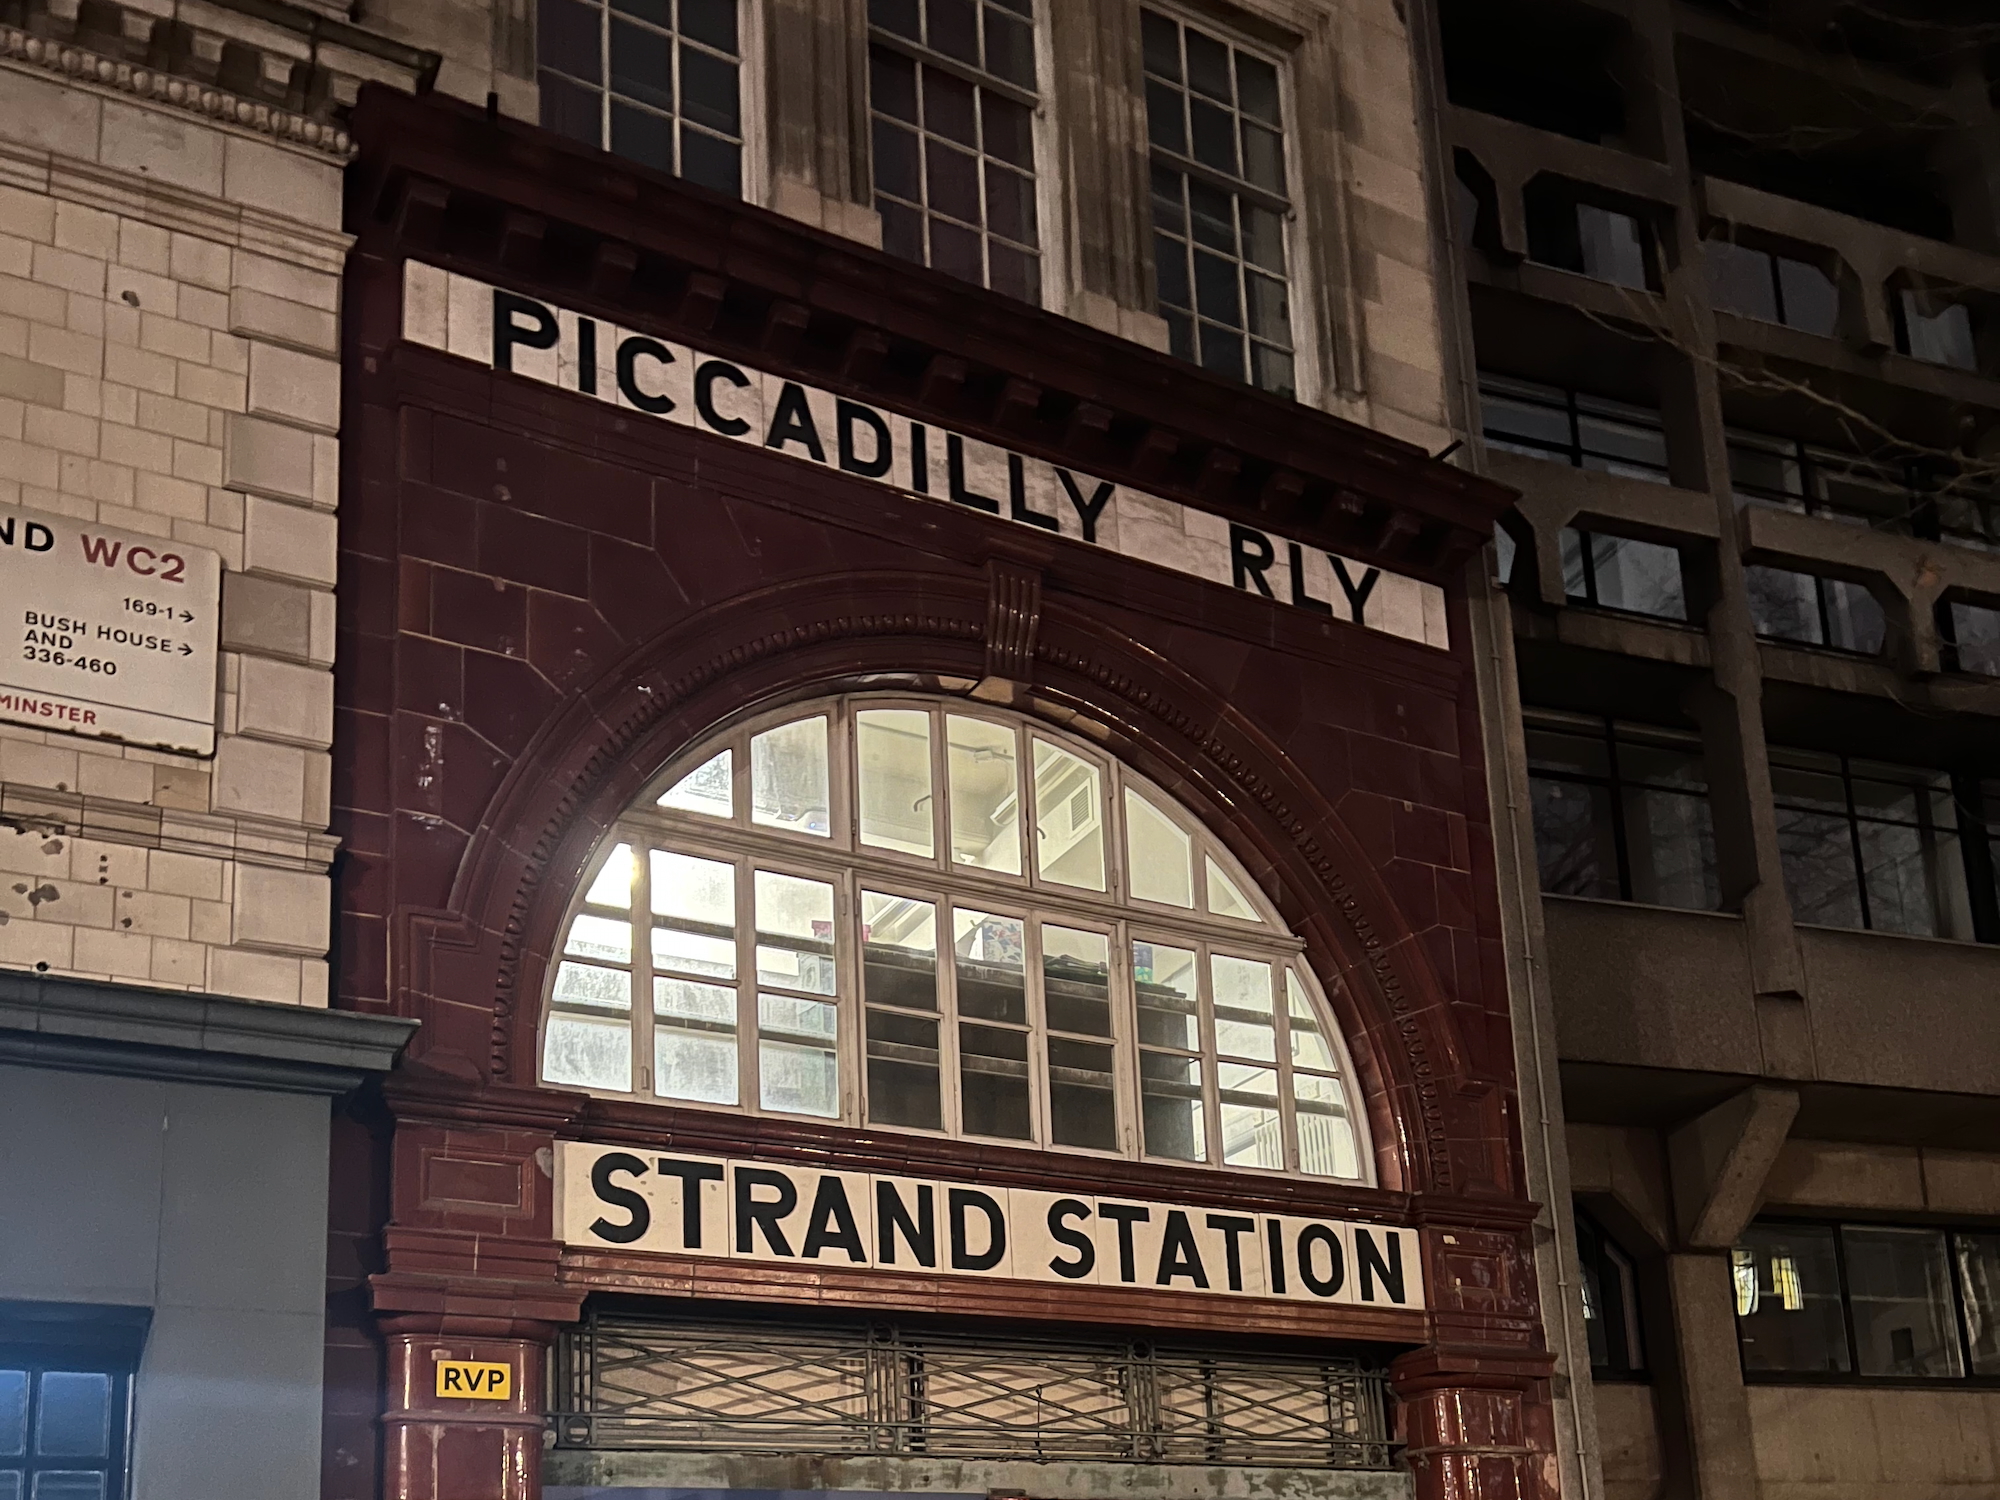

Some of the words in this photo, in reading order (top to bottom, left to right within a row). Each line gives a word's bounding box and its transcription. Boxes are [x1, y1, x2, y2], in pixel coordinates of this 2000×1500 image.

[493, 290, 1116, 545] PICCADILLY
[1229, 522, 1380, 626] RLY
[81, 534, 186, 583] WC2
[123, 597, 174, 621] 169-1
[24, 629, 73, 650] AND
[25, 610, 87, 636] BUSH
[97, 624, 173, 654] HOUSE
[23, 646, 117, 675] 336-460
[589, 1152, 1008, 1272] STRAND
[1047, 1198, 1406, 1304] STATION
[444, 1367, 505, 1392] RVP
